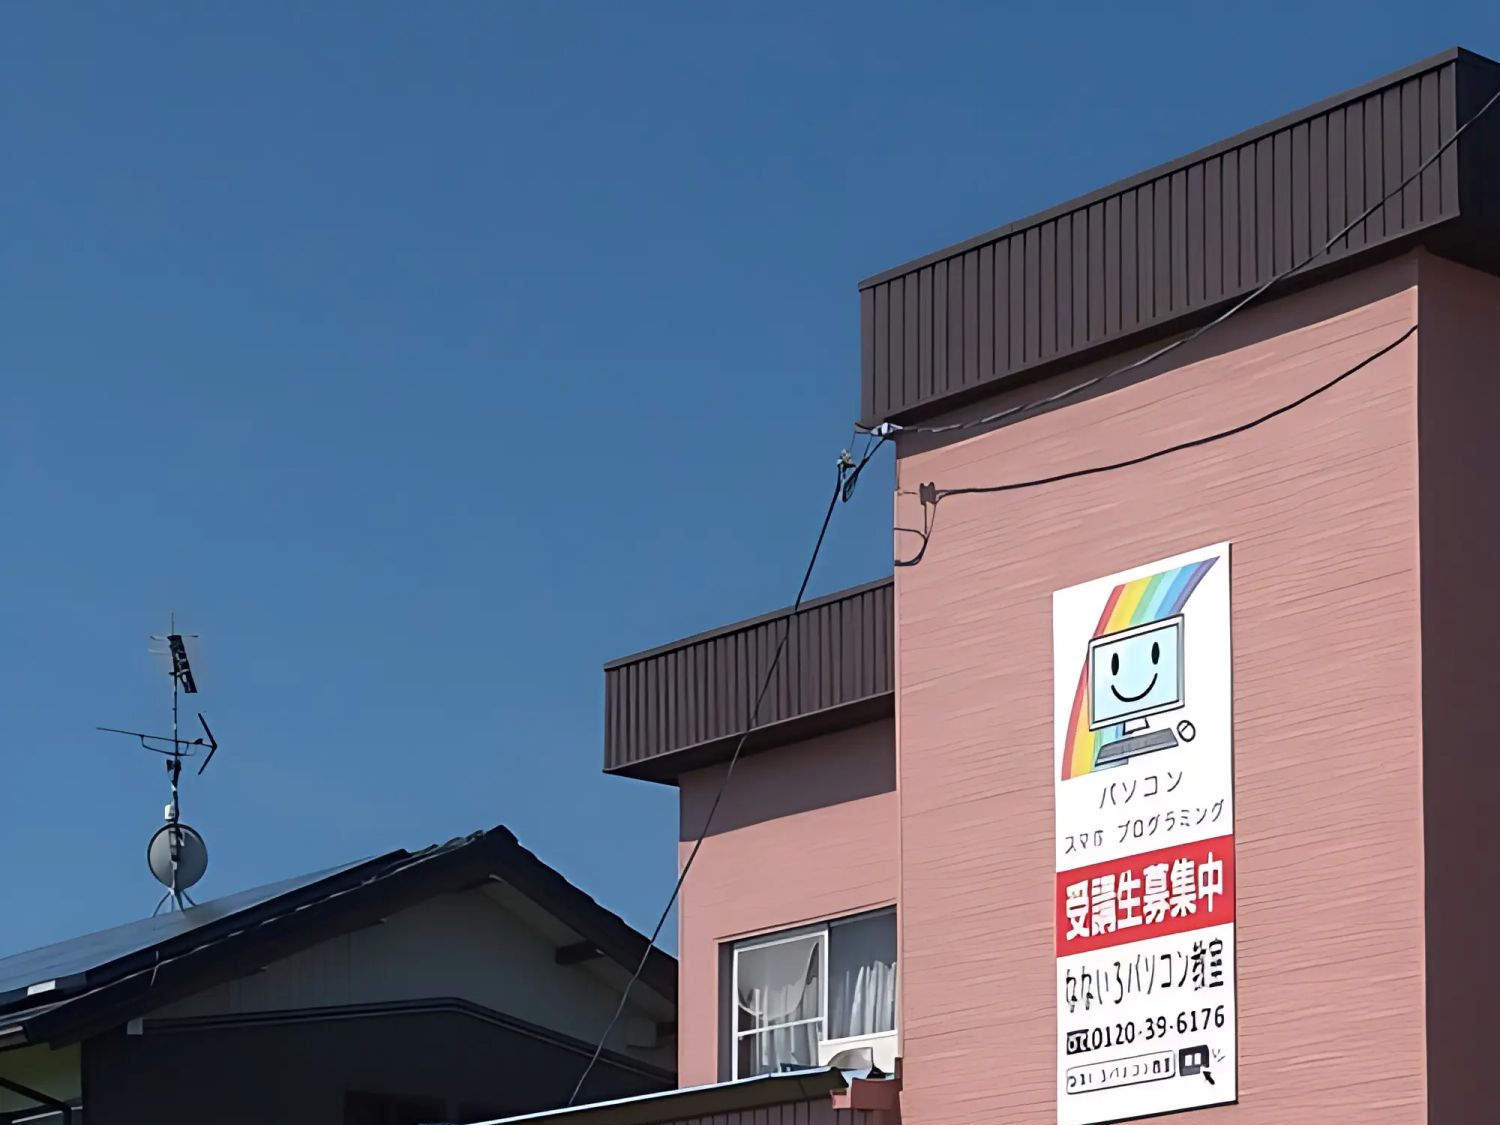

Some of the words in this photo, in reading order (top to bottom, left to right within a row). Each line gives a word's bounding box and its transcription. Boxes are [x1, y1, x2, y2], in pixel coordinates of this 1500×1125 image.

[1099, 770, 1184, 809] パソコン
[1118, 799, 1225, 843] プログラミング
[1066, 852, 1224, 941] 受講生募集中
